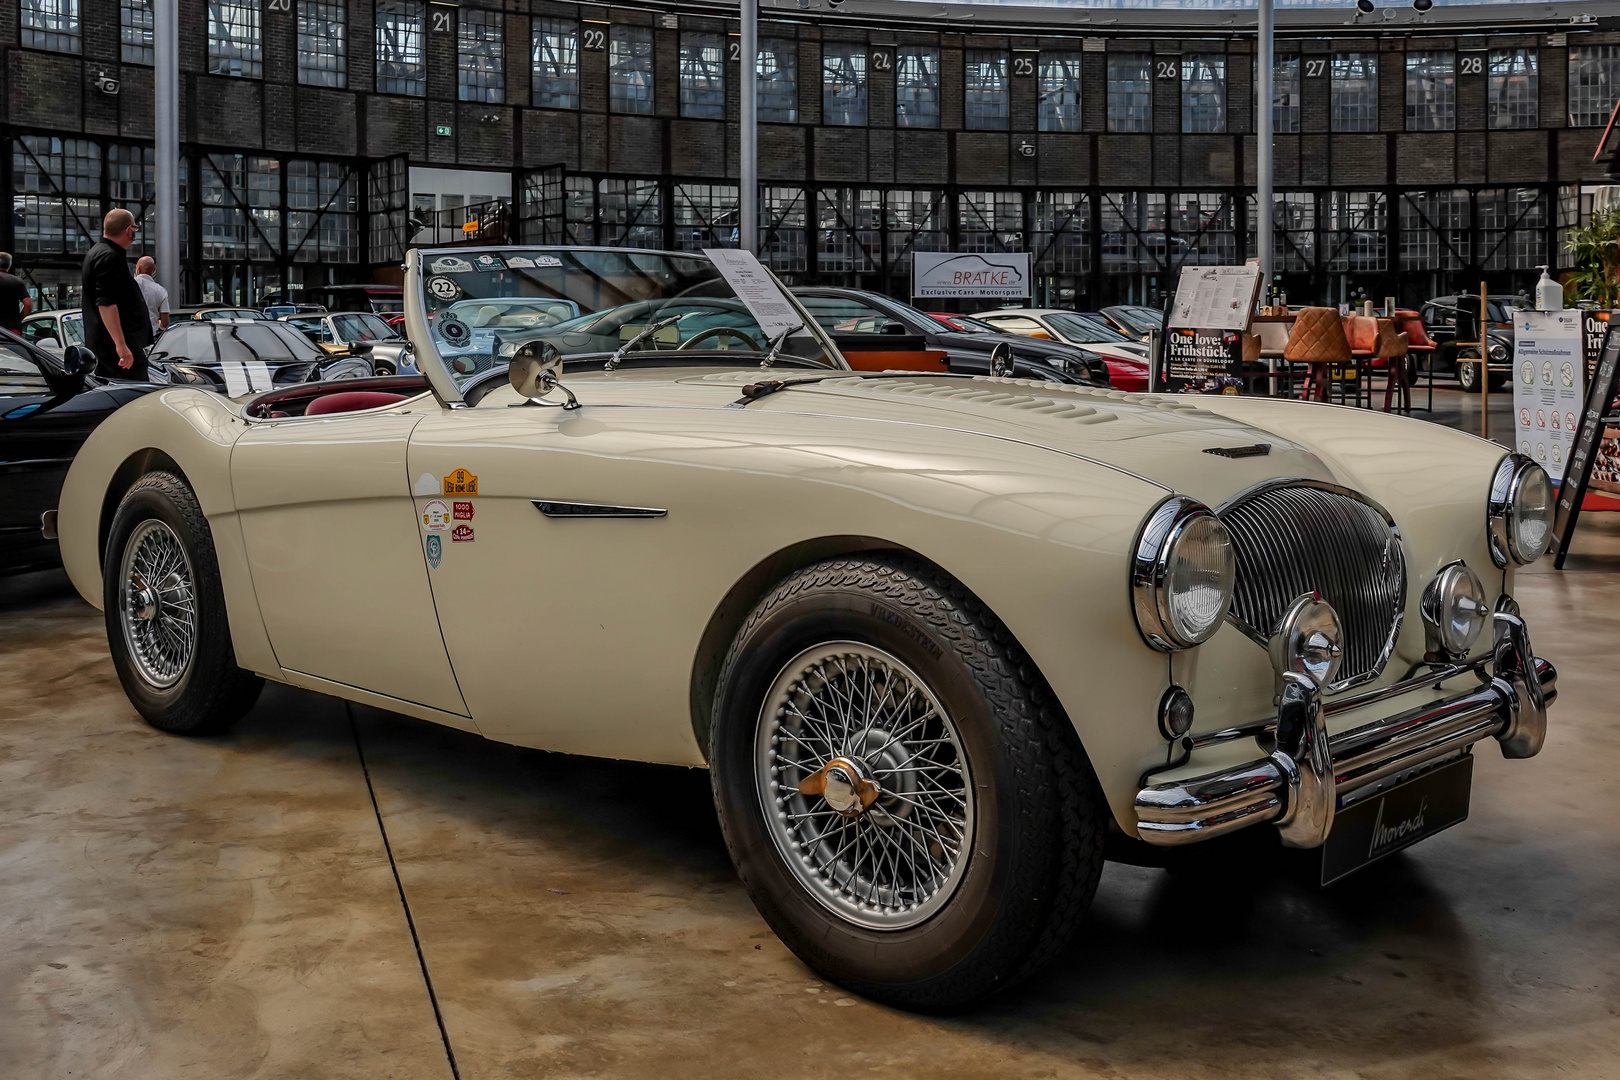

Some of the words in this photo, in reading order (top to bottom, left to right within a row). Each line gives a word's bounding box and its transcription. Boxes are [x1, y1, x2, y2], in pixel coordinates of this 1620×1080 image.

[432, 11, 450, 32] 21
[584, 29, 605, 49] 22
[730, 42, 741, 61] 2
[872, 52, 892, 70] 24
[1014, 58, 1034, 75] 25
[1156, 61, 1177, 78] 26
[1305, 60, 1326, 77] 27
[1460, 57, 1483, 74] 28
[482, 255, 489, 264] 7
[434, 282, 454, 293] 22
[980, 289, 1022, 297] Motorsport
[1586, 317, 1608, 333] One
[1170, 332, 1193, 345] One
[1195, 333, 1222, 346] love:
[1170, 344, 1232, 358] Frühstück.
[457, 471, 464, 483] 99
[454, 511, 471, 519] MIGLIA
[871, 602, 944, 660] VREDESTEIN
